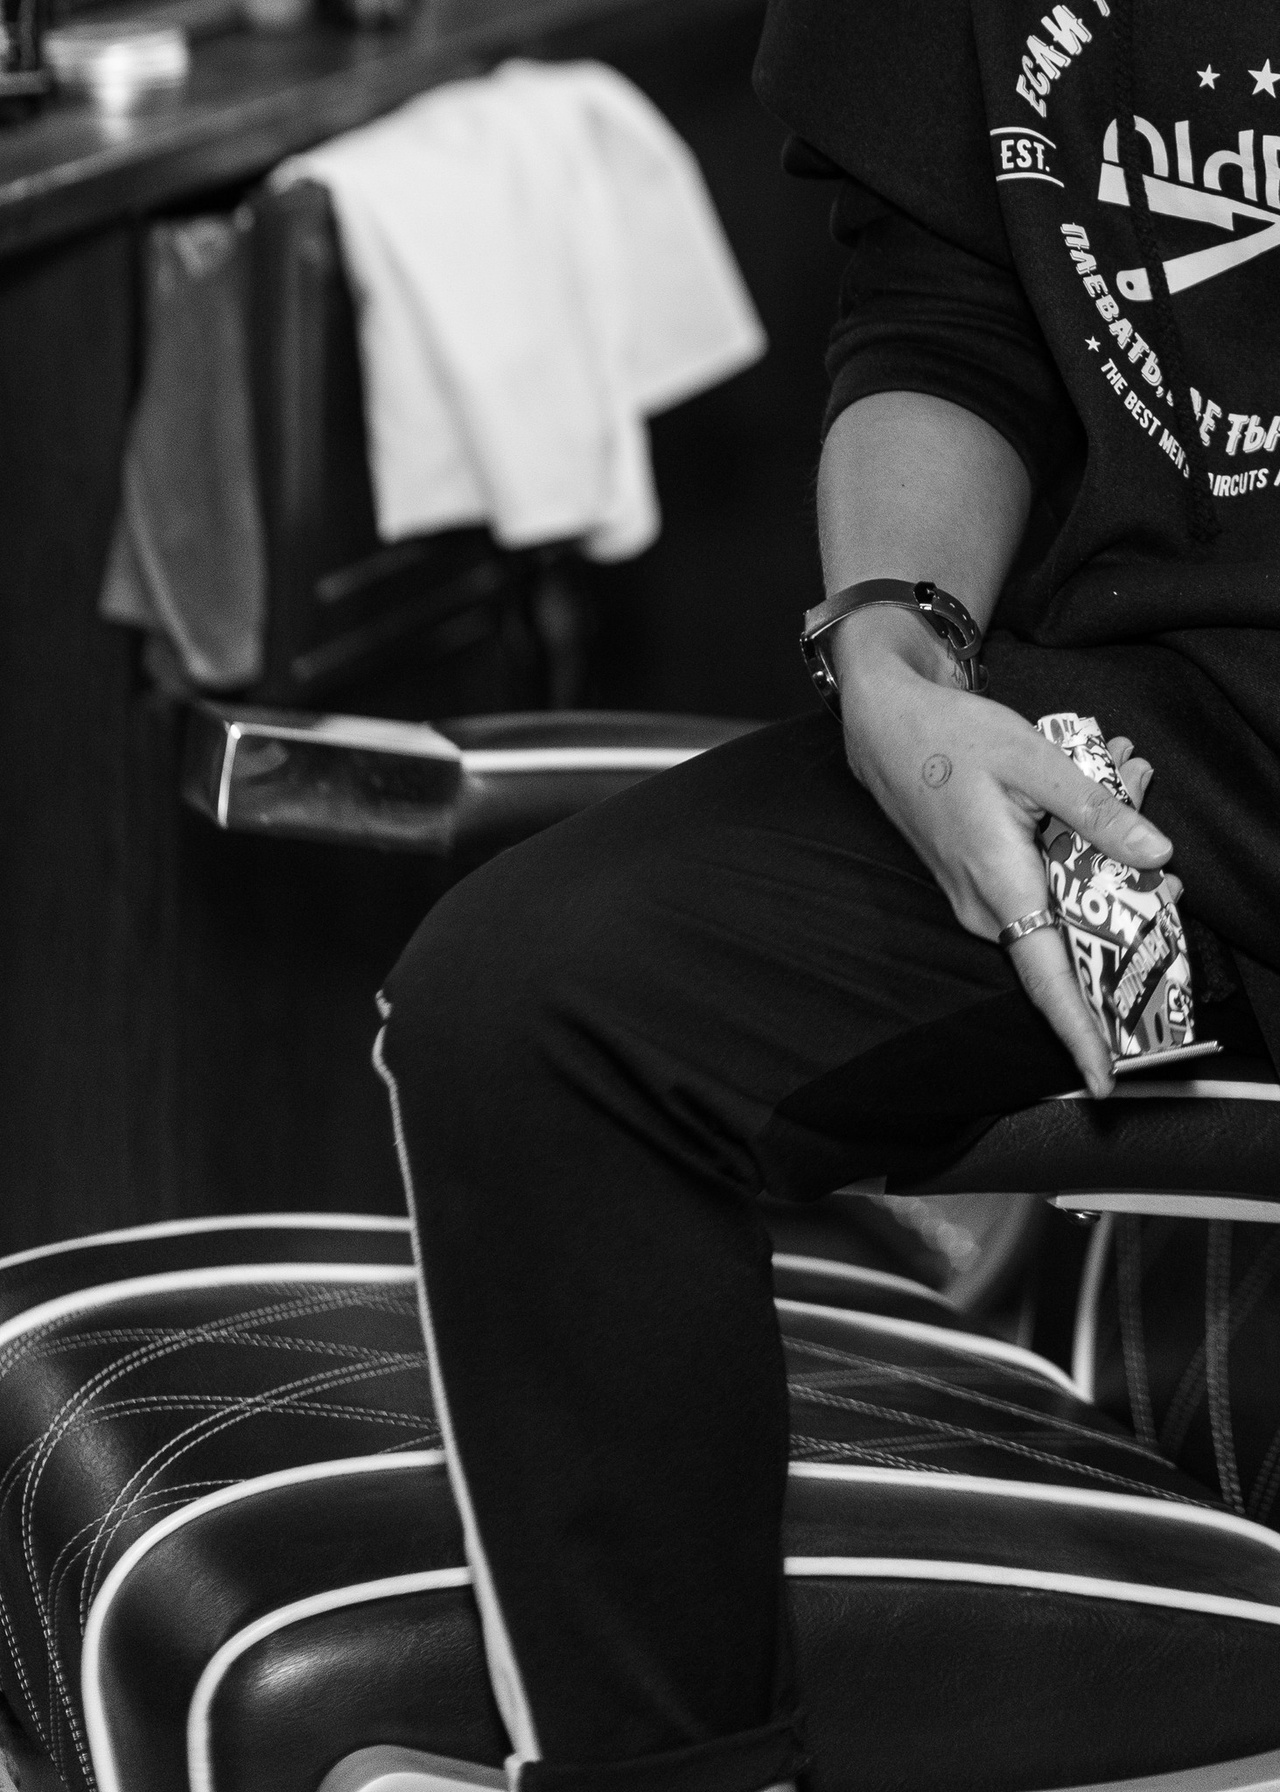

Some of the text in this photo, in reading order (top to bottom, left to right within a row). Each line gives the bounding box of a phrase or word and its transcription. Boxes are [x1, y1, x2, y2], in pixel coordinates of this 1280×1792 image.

[1015, 4, 1093, 118] ЕСЛИ
[999, 138, 1051, 174] EST.
[1100, 358, 1128, 396] THE
[1123, 390, 1162, 437] BEST
[1207, 468, 1270, 497] IRCUTS
